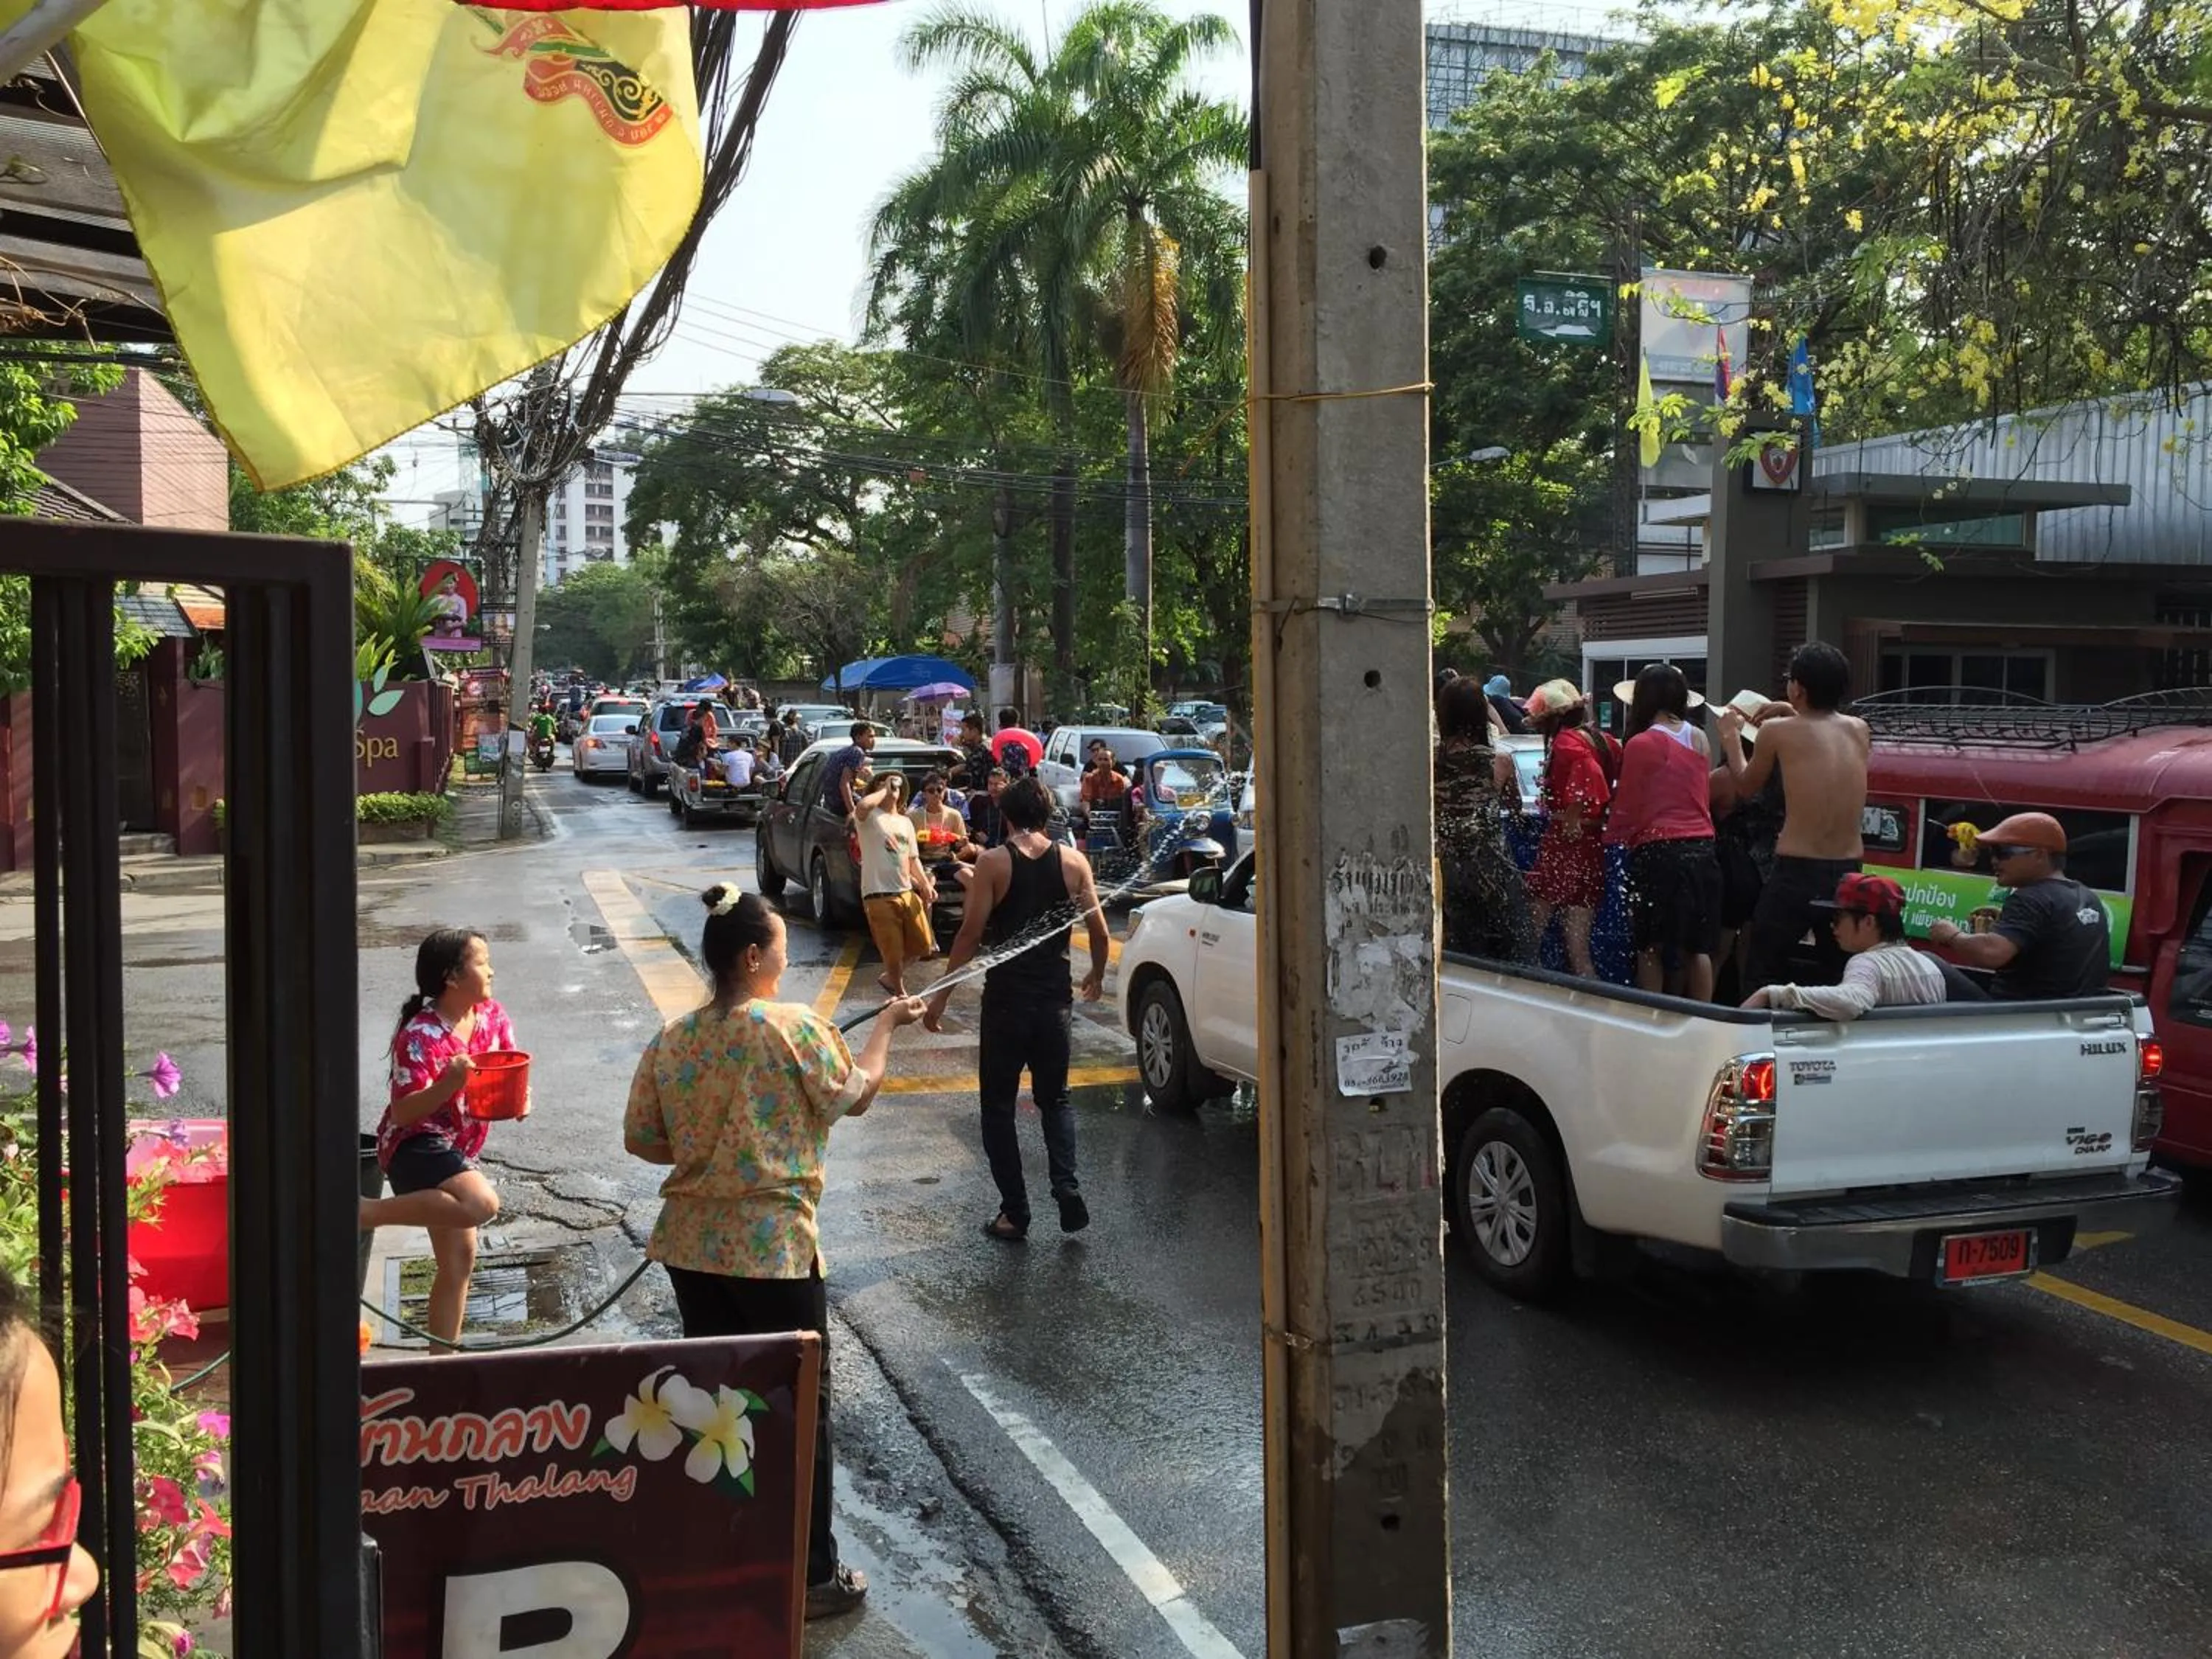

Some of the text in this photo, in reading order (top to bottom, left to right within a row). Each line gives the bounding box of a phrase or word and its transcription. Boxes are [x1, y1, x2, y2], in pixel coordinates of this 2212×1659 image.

[1905, 880, 1956, 909] ปกป้อง
[2080, 1042, 2126, 1057] HILUX
[1790, 1060, 1837, 1072] TOYOTA
[2066, 1132, 2112, 1145] VIGO
[361, 1463, 637, 1515] aan Thalang
